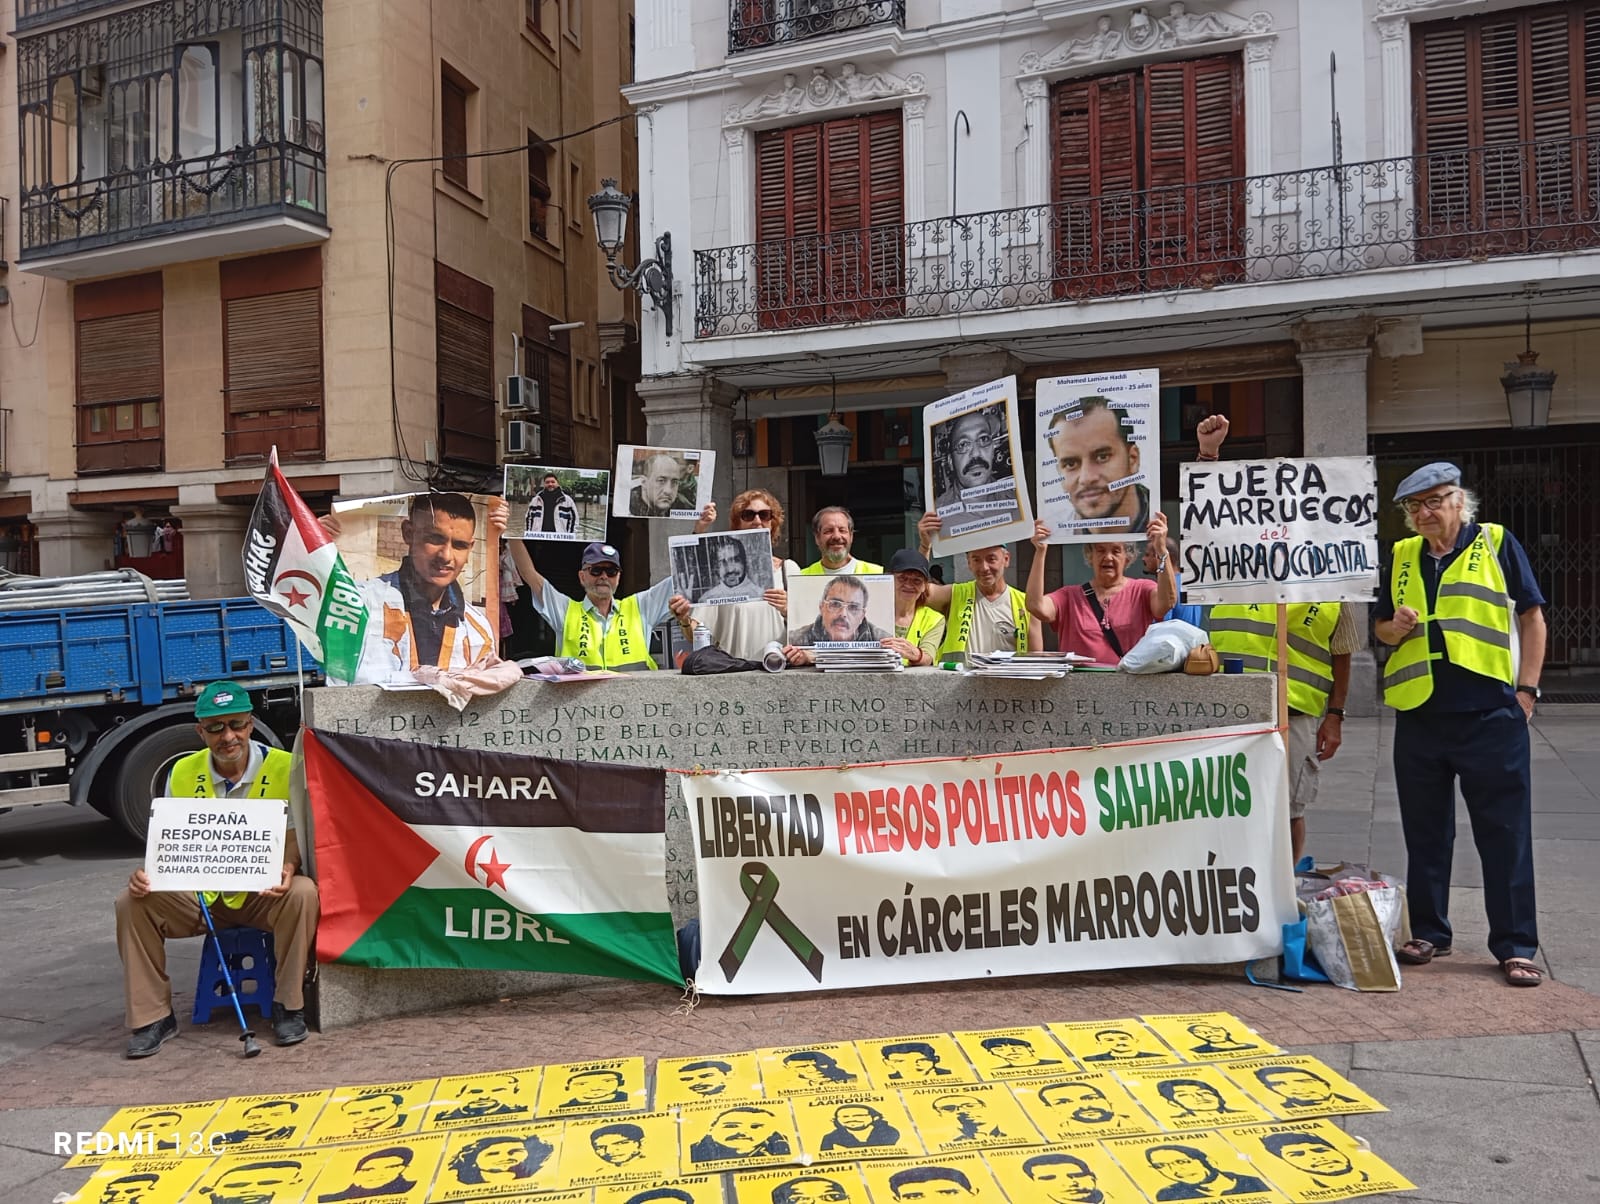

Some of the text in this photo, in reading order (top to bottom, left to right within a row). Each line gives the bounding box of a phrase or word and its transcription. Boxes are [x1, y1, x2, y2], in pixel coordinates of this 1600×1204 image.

[1057, 377, 1086, 385] Mohamed
[1137, 382, 1152, 390] años
[1053, 400, 1080, 412] infectado
[1042, 476, 1065, 487] Enuresis
[1110, 474, 1145, 489] Aislamiento
[1188, 463, 1327, 501] FUERA
[962, 488, 985, 497] deterioro
[999, 500, 1015, 508] pecho
[1183, 492, 1375, 530] MARRUECOS
[960, 521, 991, 532] tratamiento
[991, 516, 1010, 525] médico
[1260, 526, 1290, 541] del
[1269, 540, 1375, 581] OCCIDENTAL
[1397, 561, 1411, 606] SAHAR
[958, 598, 974, 642] SAHARA
[578, 614, 590, 657] SAHARA
[336, 698, 1250, 734] EL DIA 12 DE JVNIO DE 1985 SE FIRMO EN MADRID EL TRATADO
[484, 729, 562, 747] REINO
[577, 725, 606, 741] DE
[621, 722, 731, 740] BELGICA,
[742, 720, 768, 735] EL
[784, 719, 856, 734] REINO
[865, 719, 893, 733] DE
[694, 743, 722, 757] LA
[748, 739, 880, 755] REPVBLICA
[414, 771, 557, 800] SAHARA
[696, 752, 1252, 858] LIBERTAD PRESOS POLÍTICOS SAHARAUIS
[188, 811, 248, 825] ESPAÑA
[161, 829, 271, 841] RESPONSABLE
[158, 843, 272, 853] POR SER LA POTENCIA
[157, 855, 270, 863] ADMINISTRADORA DEL
[158, 866, 268, 874] SAHARA OCCIDENTAL
[838, 851, 1260, 960] EN CÁRCELES MARROQUÍES
[569, 1062, 625, 1073] BABEIT
[1016, 1073, 1104, 1087] MOHAMED BANI
[358, 1085, 413, 1096] HADDI
[912, 1084, 994, 1096] AHMED SBAI
[236, 1095, 286, 1104] HUSEIN
[732, 1099, 785, 1108] SIDAHMED
[808, 1096, 884, 1107] LAAROUSSI
[126, 1101, 216, 1114] HASSAN DAH
[571, 1112, 670, 1127] AZIZ ALUAHADI
[1173, 1117, 1220, 1127] Libertad
[1232, 1122, 1324, 1136] CHEJ BANGA
[1114, 1133, 1209, 1147] NAAMA ASFARI
[989, 1149, 1041, 1158] ABDELLAH
[1073, 1142, 1095, 1150] SIDI
[915, 1154, 975, 1166] LAKHFAWNI
[739, 1165, 853, 1182] BRAHIM ISMAILI
[608, 1176, 709, 1194] SALEK LAASIRI
[1300, 1180, 1394, 1198] Libertad Presos
[525, 1191, 585, 1203] FOURTAT
